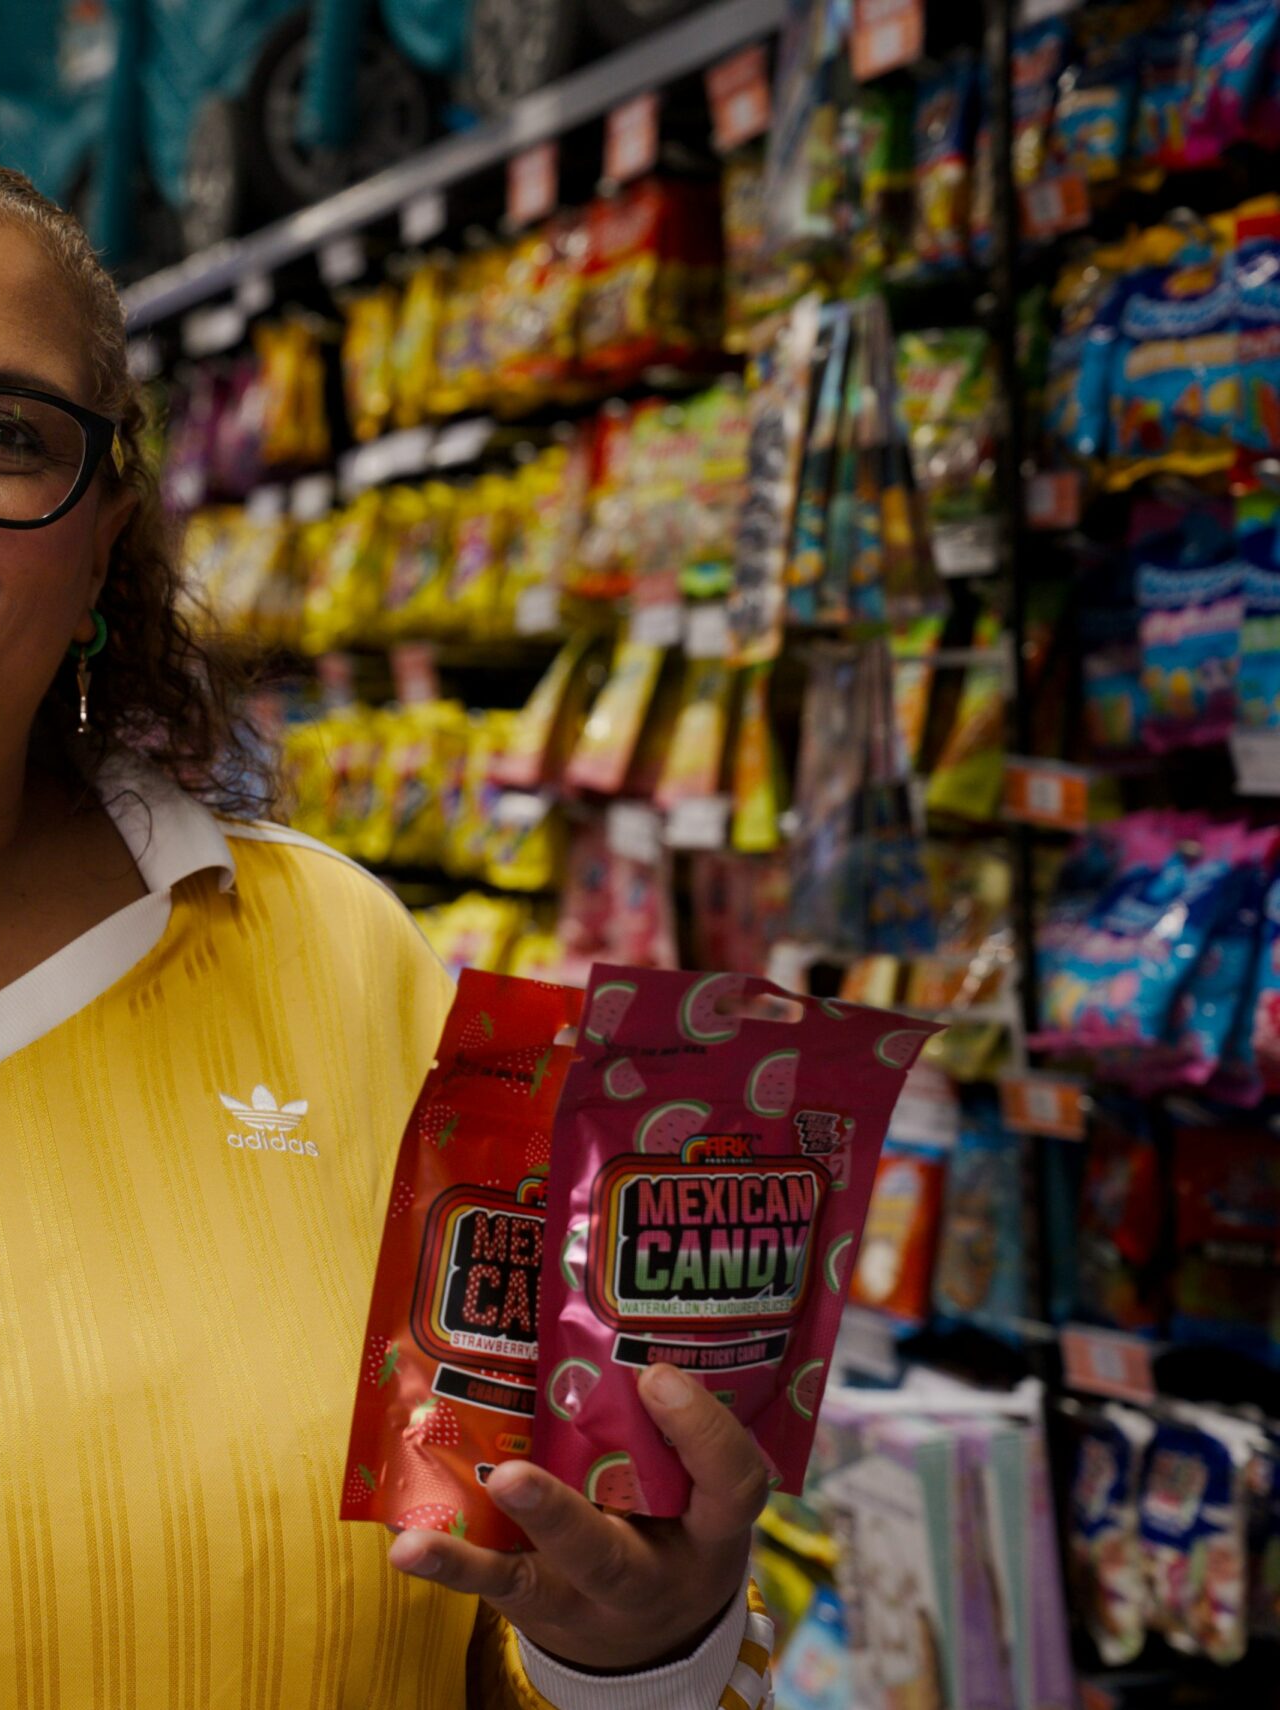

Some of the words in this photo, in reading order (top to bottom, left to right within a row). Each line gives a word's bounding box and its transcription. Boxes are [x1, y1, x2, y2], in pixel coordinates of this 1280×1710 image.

[227, 1131, 319, 1157] adidas
[705, 1135, 753, 1158] ARK
[638, 1177, 814, 1225] MEXICAN
[635, 1227, 809, 1292] CANDY
[462, 1264, 542, 1333] CA
[621, 1301, 699, 1314] WATERMELON
[704, 1301, 759, 1314] FLAVOURED
[453, 1333, 529, 1357] STRAWBERRY
